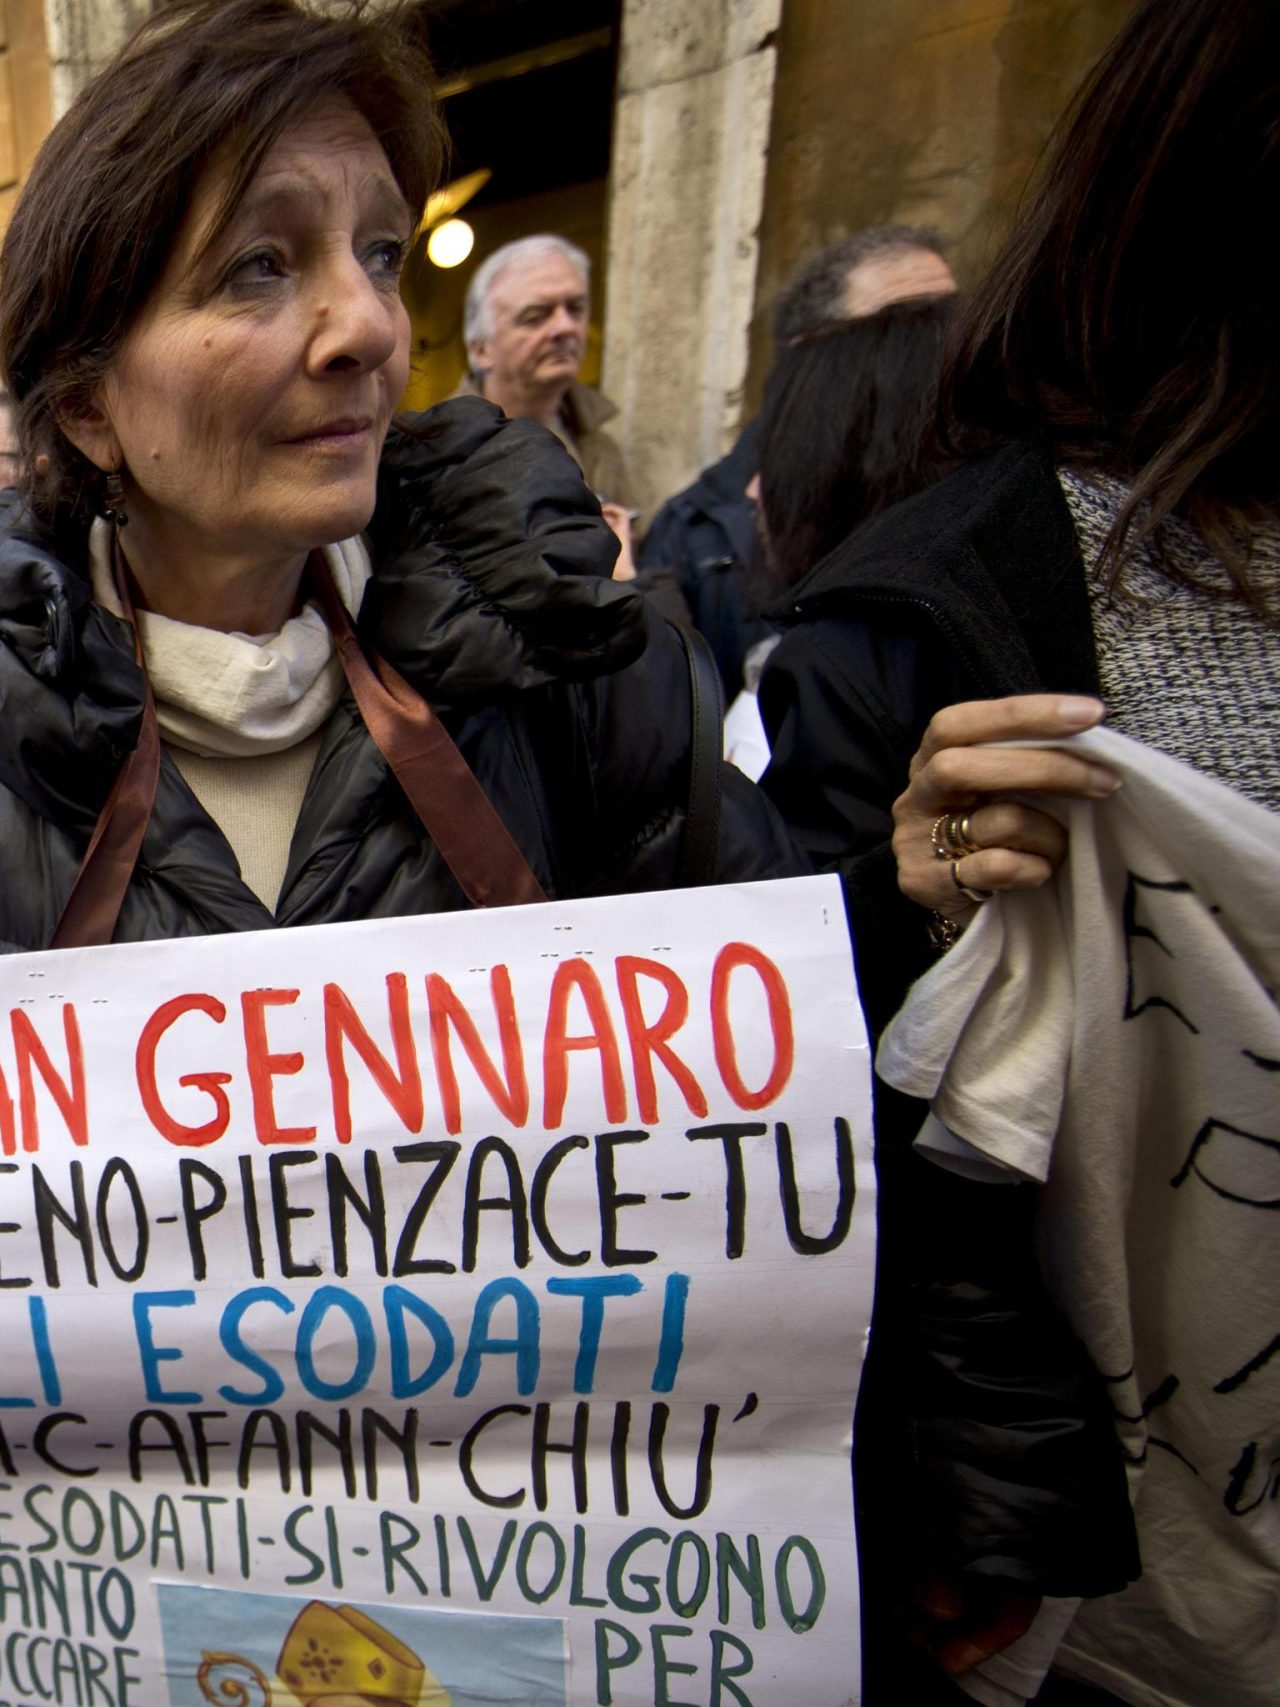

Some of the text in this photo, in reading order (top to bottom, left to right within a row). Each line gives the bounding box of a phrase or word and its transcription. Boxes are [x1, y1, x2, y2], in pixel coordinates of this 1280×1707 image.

[135, 941, 795, 1147] GENNARO
[132, 1271, 693, 1407] ESODATI
[594, 1618, 755, 1707] PER
